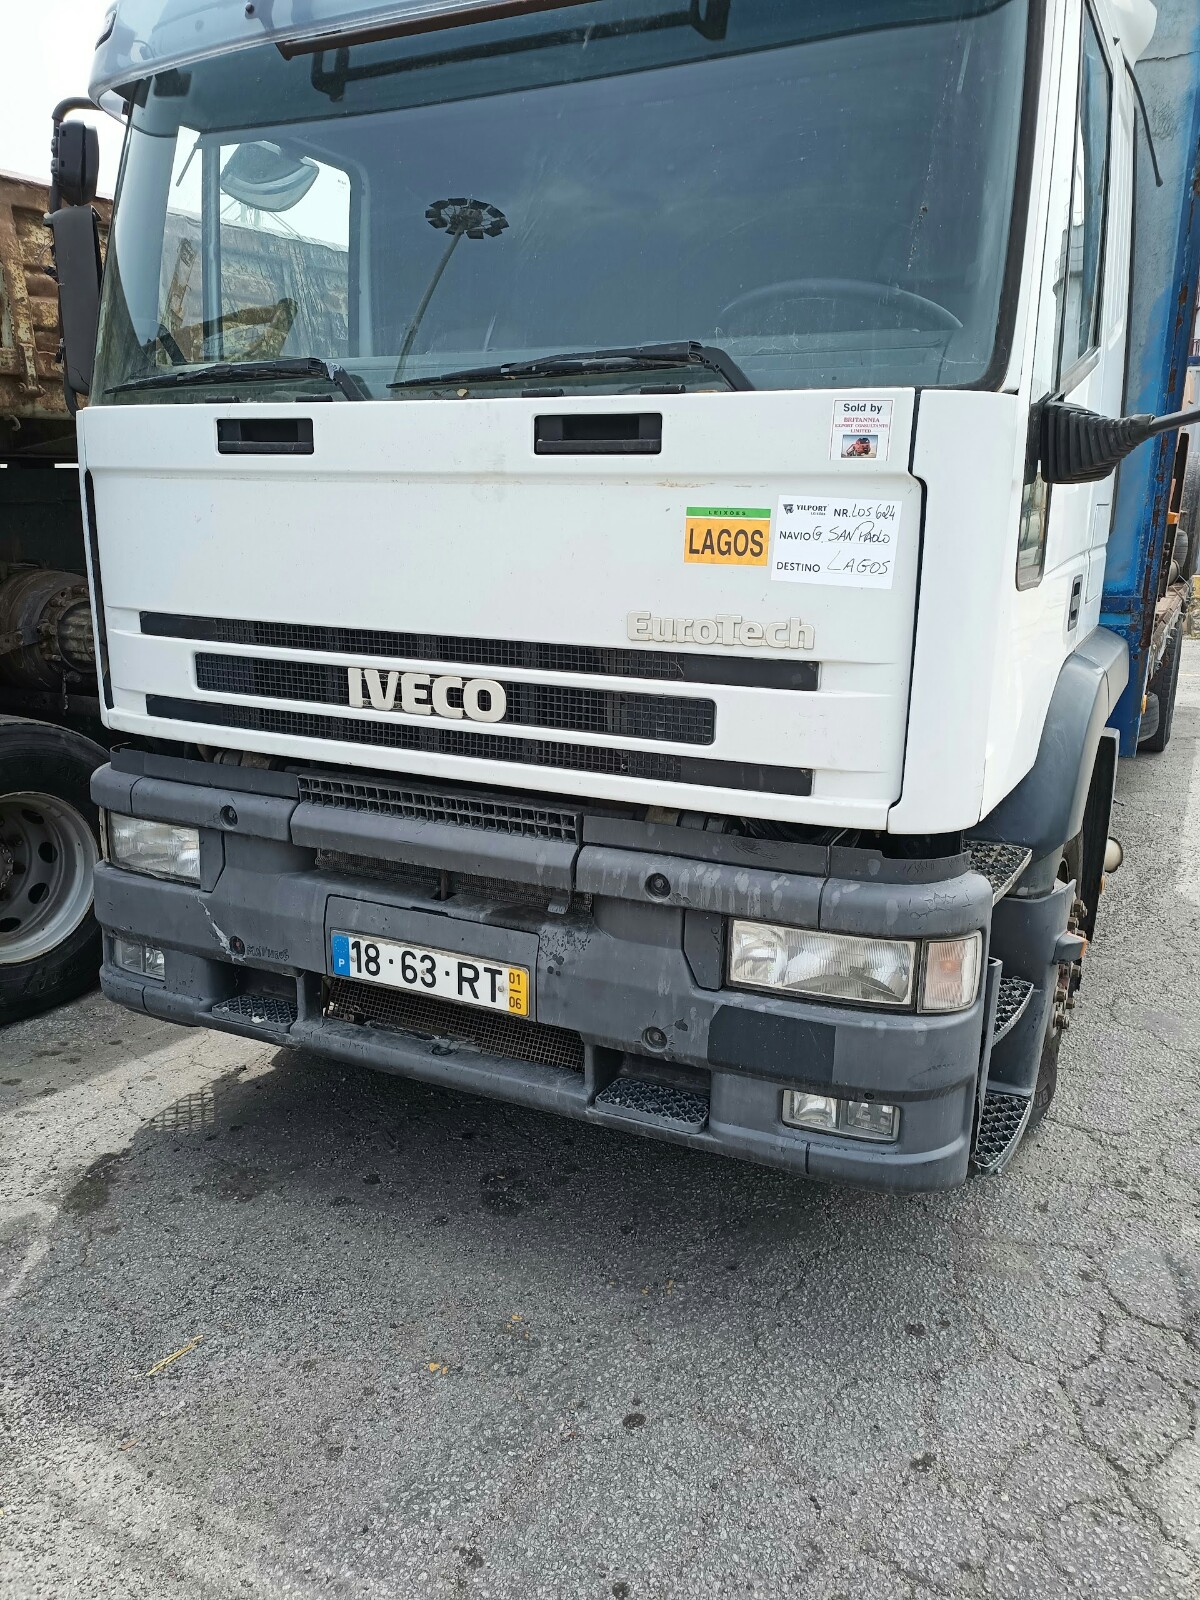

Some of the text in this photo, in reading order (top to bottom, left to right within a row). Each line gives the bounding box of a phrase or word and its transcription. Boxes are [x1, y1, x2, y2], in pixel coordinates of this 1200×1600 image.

[843, 403, 882, 414] Sold by
[796, 504, 828, 512] YILPORT
[779, 530, 811, 541] NAVIO
[827, 525, 857, 542] SAN
[688, 528, 764, 557] LAGOS
[776, 550, 891, 575] DESTINO LAGOS
[626, 610, 816, 650] EuroTech
[346, 667, 508, 723] IVECO
[338, 958, 345, 968] P
[508, 972, 522, 986] 01
[508, 995, 522, 1010] 06
